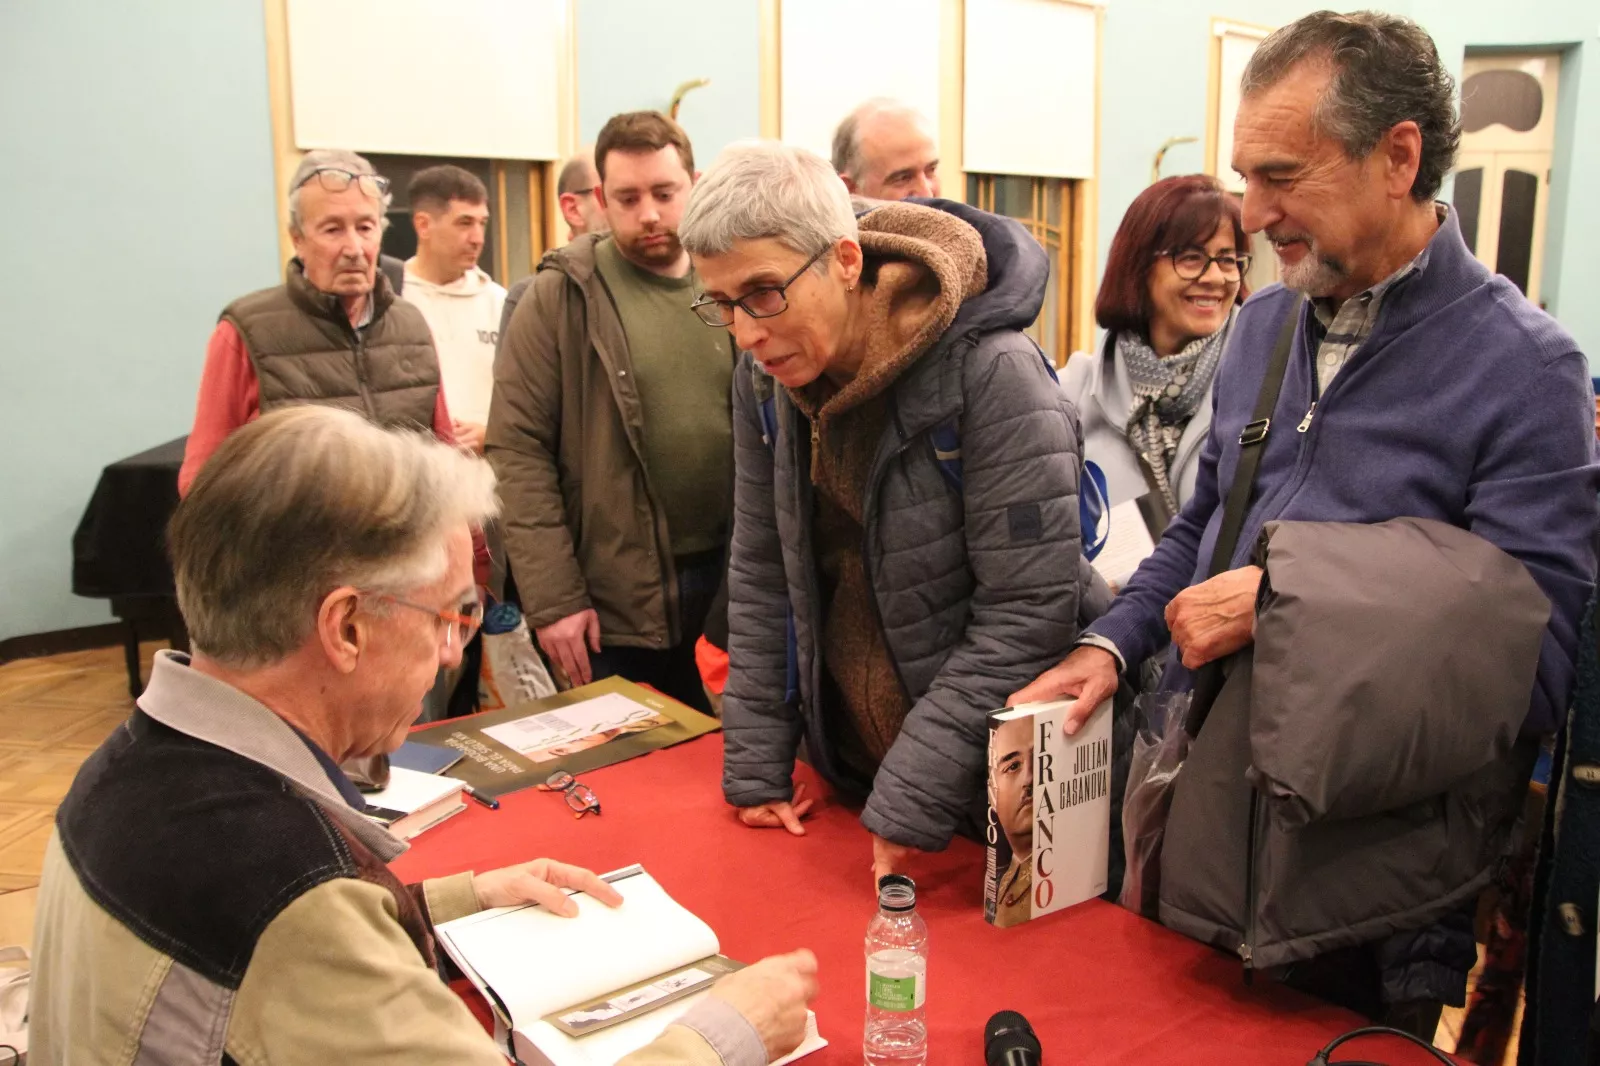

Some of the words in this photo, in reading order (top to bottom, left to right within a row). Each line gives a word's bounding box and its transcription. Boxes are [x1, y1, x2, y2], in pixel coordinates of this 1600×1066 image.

[987, 728, 998, 845] FRANCO
[1060, 772, 1107, 809] CASANOVA
[1074, 737, 1108, 775] JULIÁN
[1036, 721, 1054, 908] FRANCO
